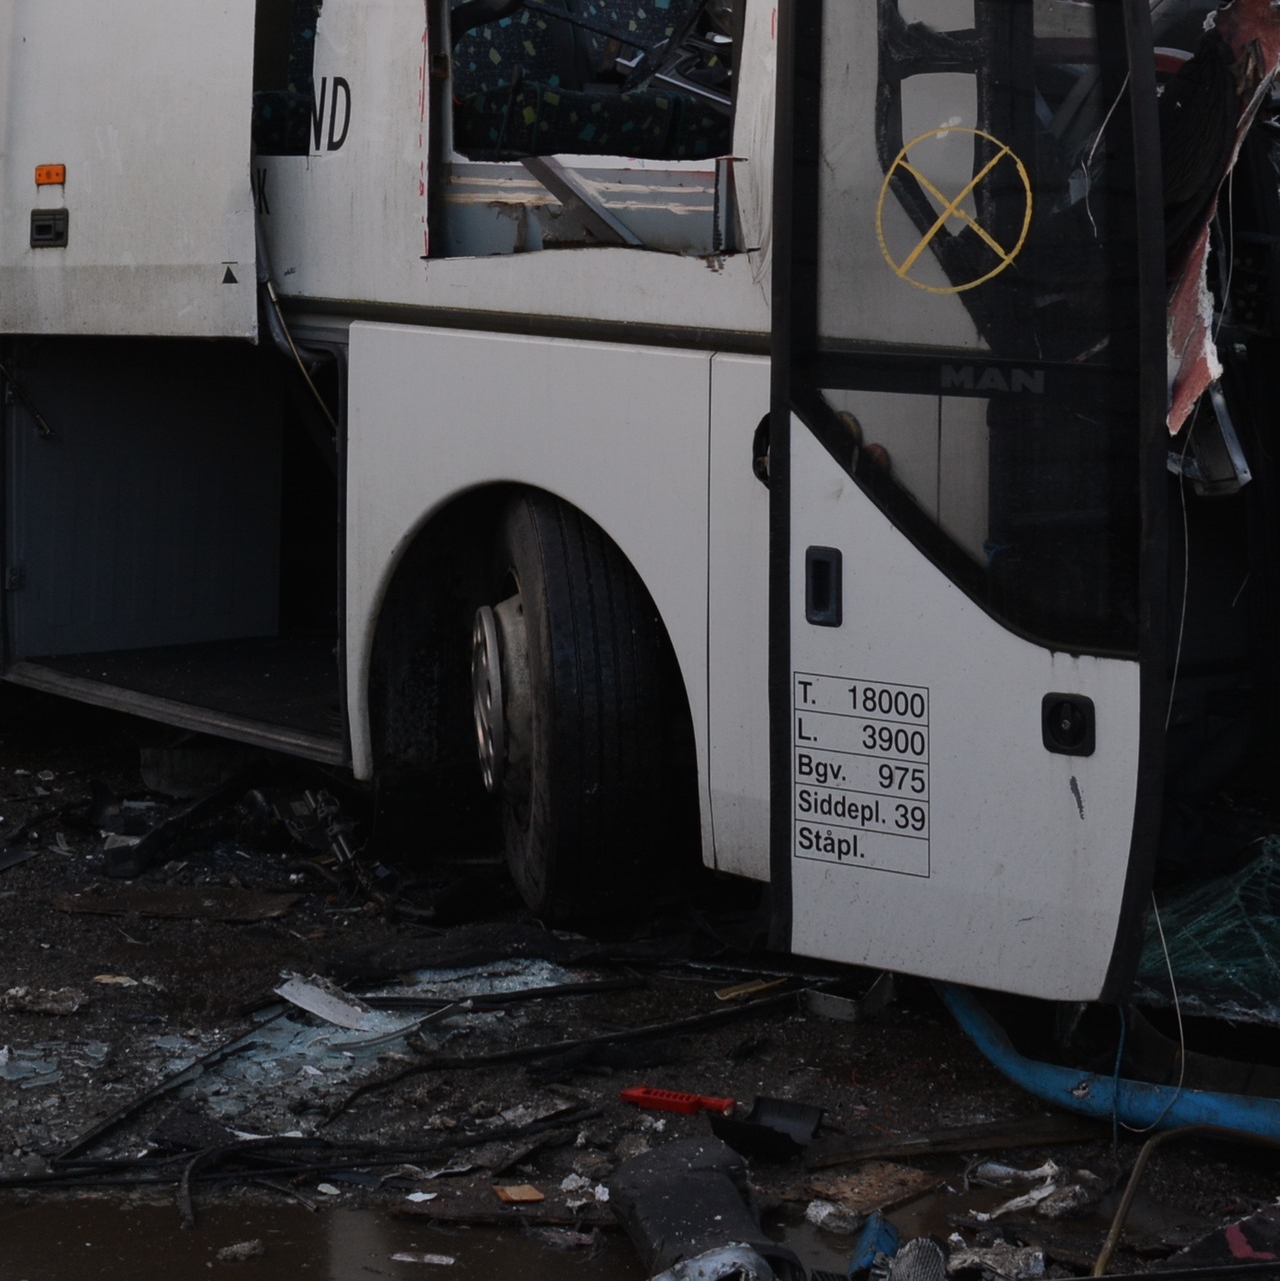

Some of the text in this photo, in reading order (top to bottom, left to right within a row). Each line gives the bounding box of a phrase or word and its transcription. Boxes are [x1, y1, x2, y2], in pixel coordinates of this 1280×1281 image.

[940, 364, 1046, 394] MAN
[798, 680, 925, 719] T. 18000
[798, 717, 926, 756] L. 3900
[798, 753, 926, 794] Bgv. 975
[798, 789, 926, 832] Siddepl. 39
[798, 826, 865, 861] Ståpl.
